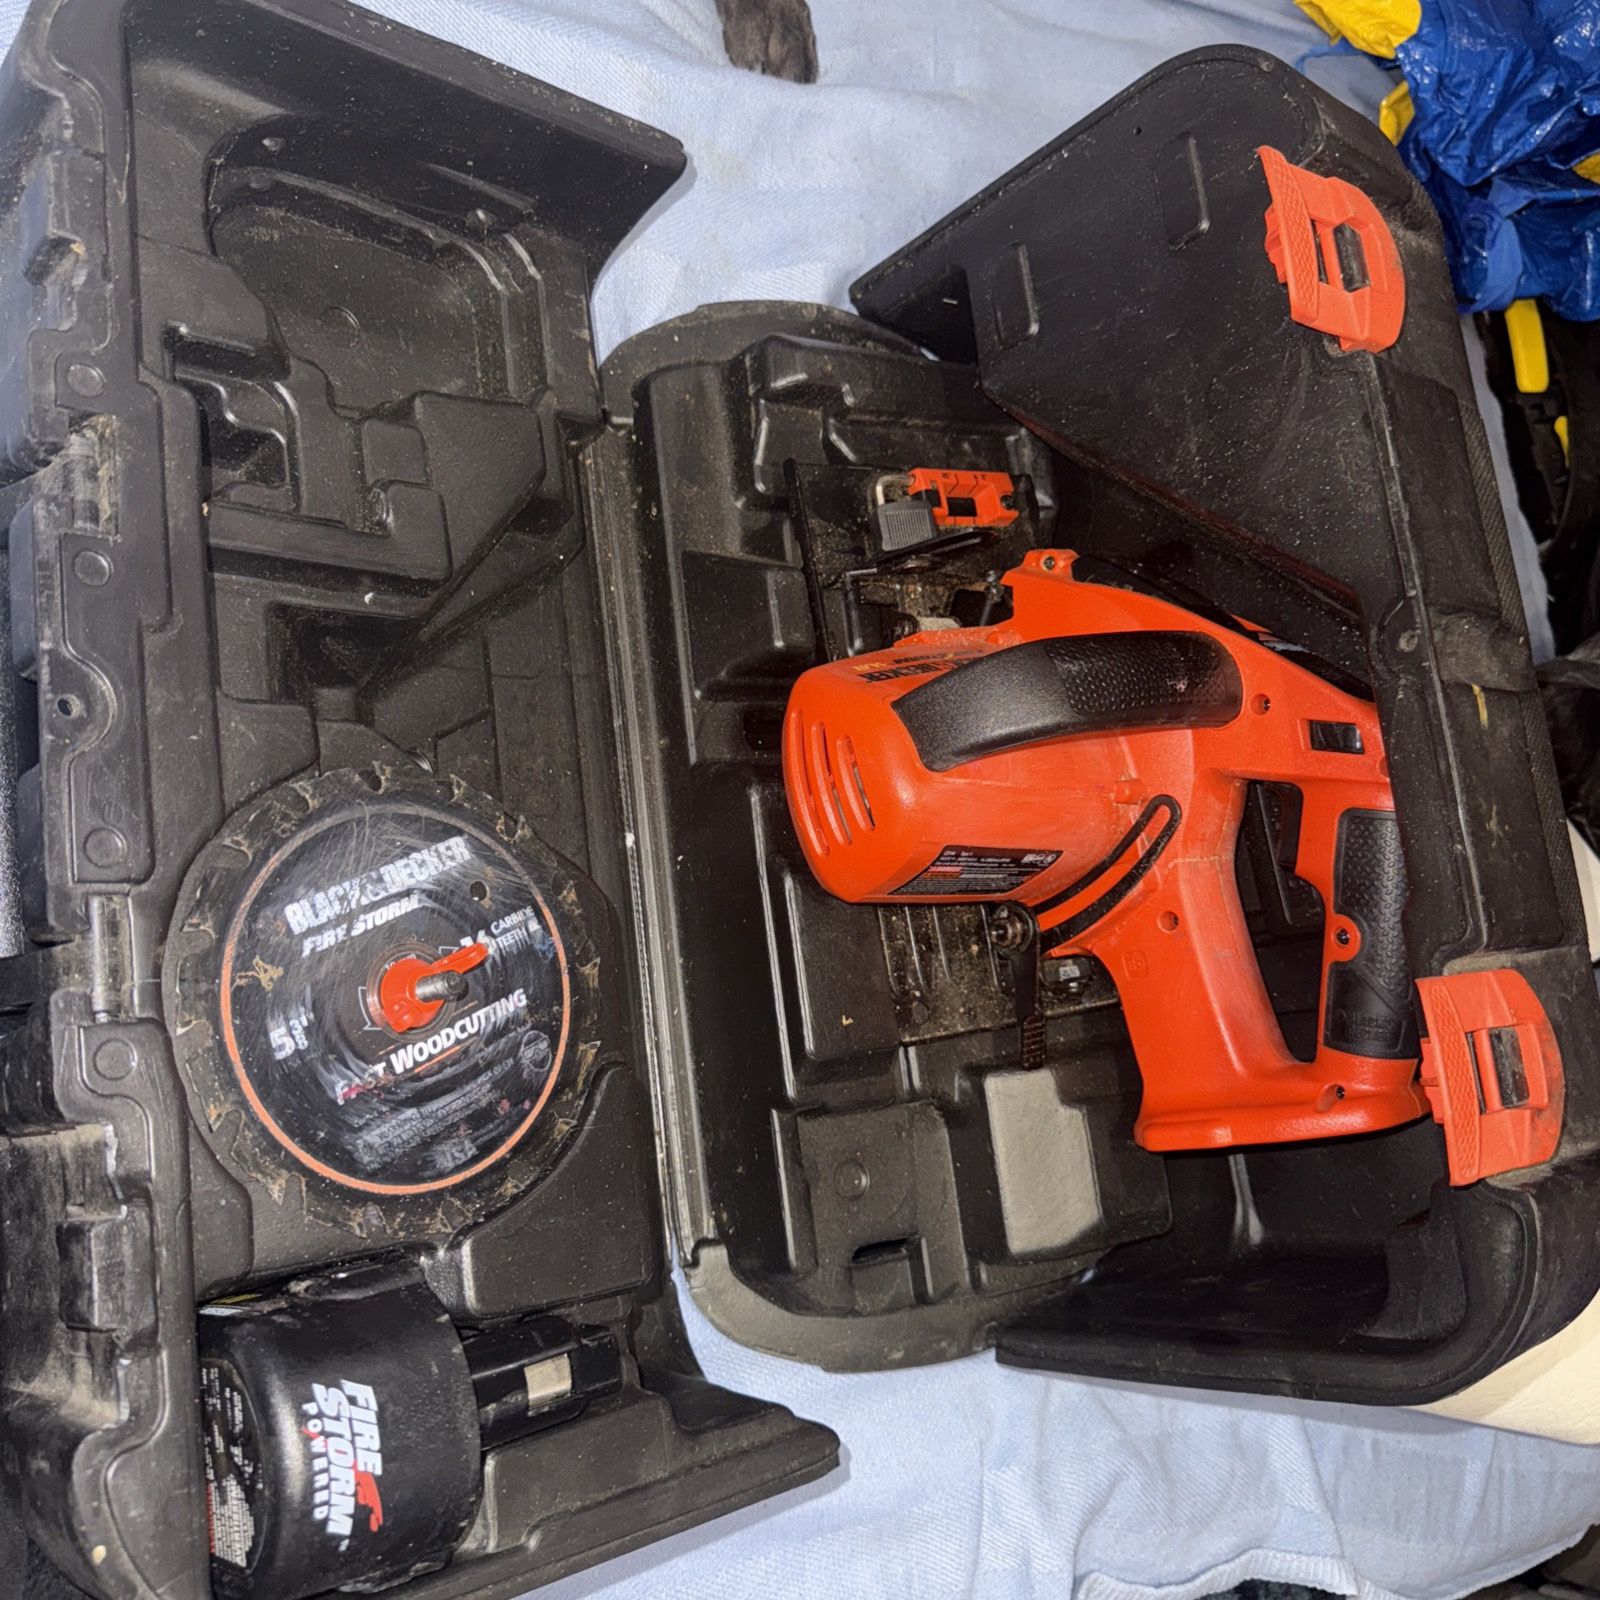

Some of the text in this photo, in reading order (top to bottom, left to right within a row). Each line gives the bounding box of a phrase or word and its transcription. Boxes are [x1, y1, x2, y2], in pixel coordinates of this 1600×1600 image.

[351, 892, 419, 937] STORM
[490, 905, 535, 935] CARBIDE
[496, 926, 529, 949] TEETH
[390, 988, 528, 1075] WOODCUTTING
[301, 1401, 329, 1520] POWERED
[311, 1383, 356, 1536] STORM
[340, 1379, 383, 1476] FIRE
